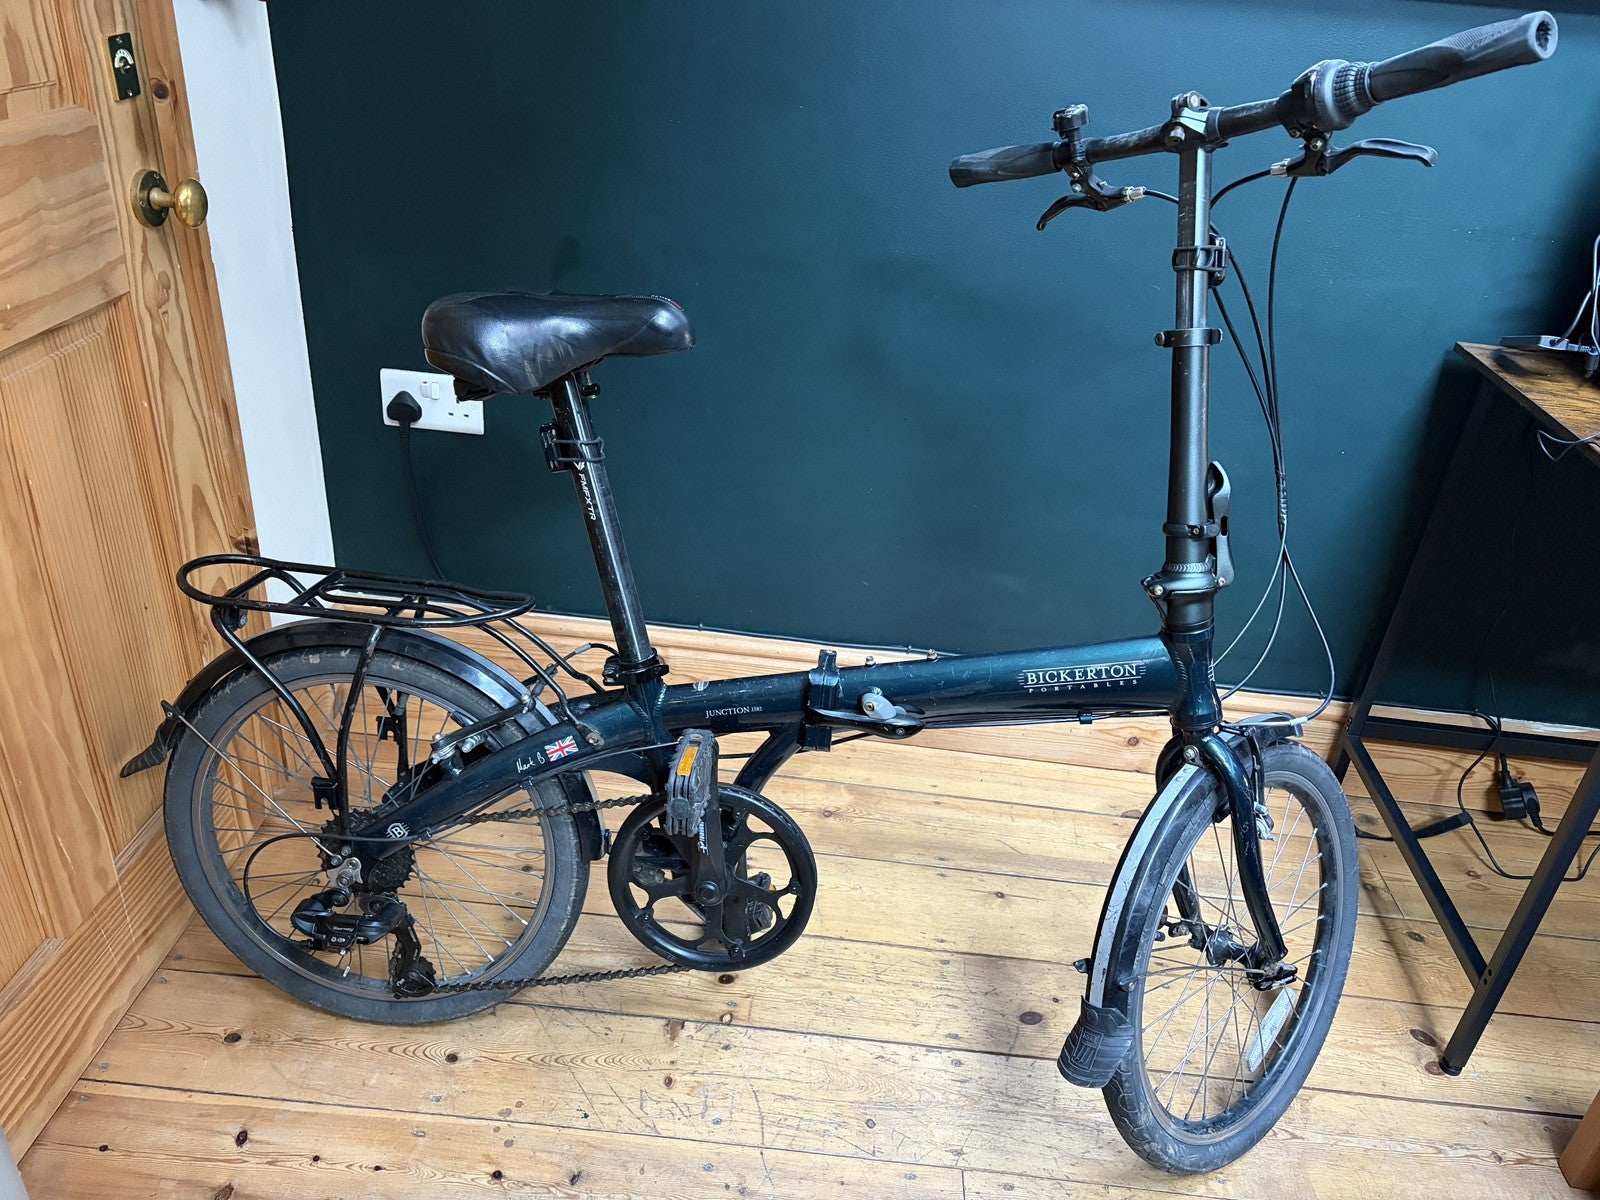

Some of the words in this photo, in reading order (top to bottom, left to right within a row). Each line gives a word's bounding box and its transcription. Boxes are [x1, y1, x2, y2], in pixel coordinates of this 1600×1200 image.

[1026, 663, 1137, 685] BICKERTON
[1028, 679, 1138, 693] PORTABLES
[705, 706, 750, 719] JUNCTION
